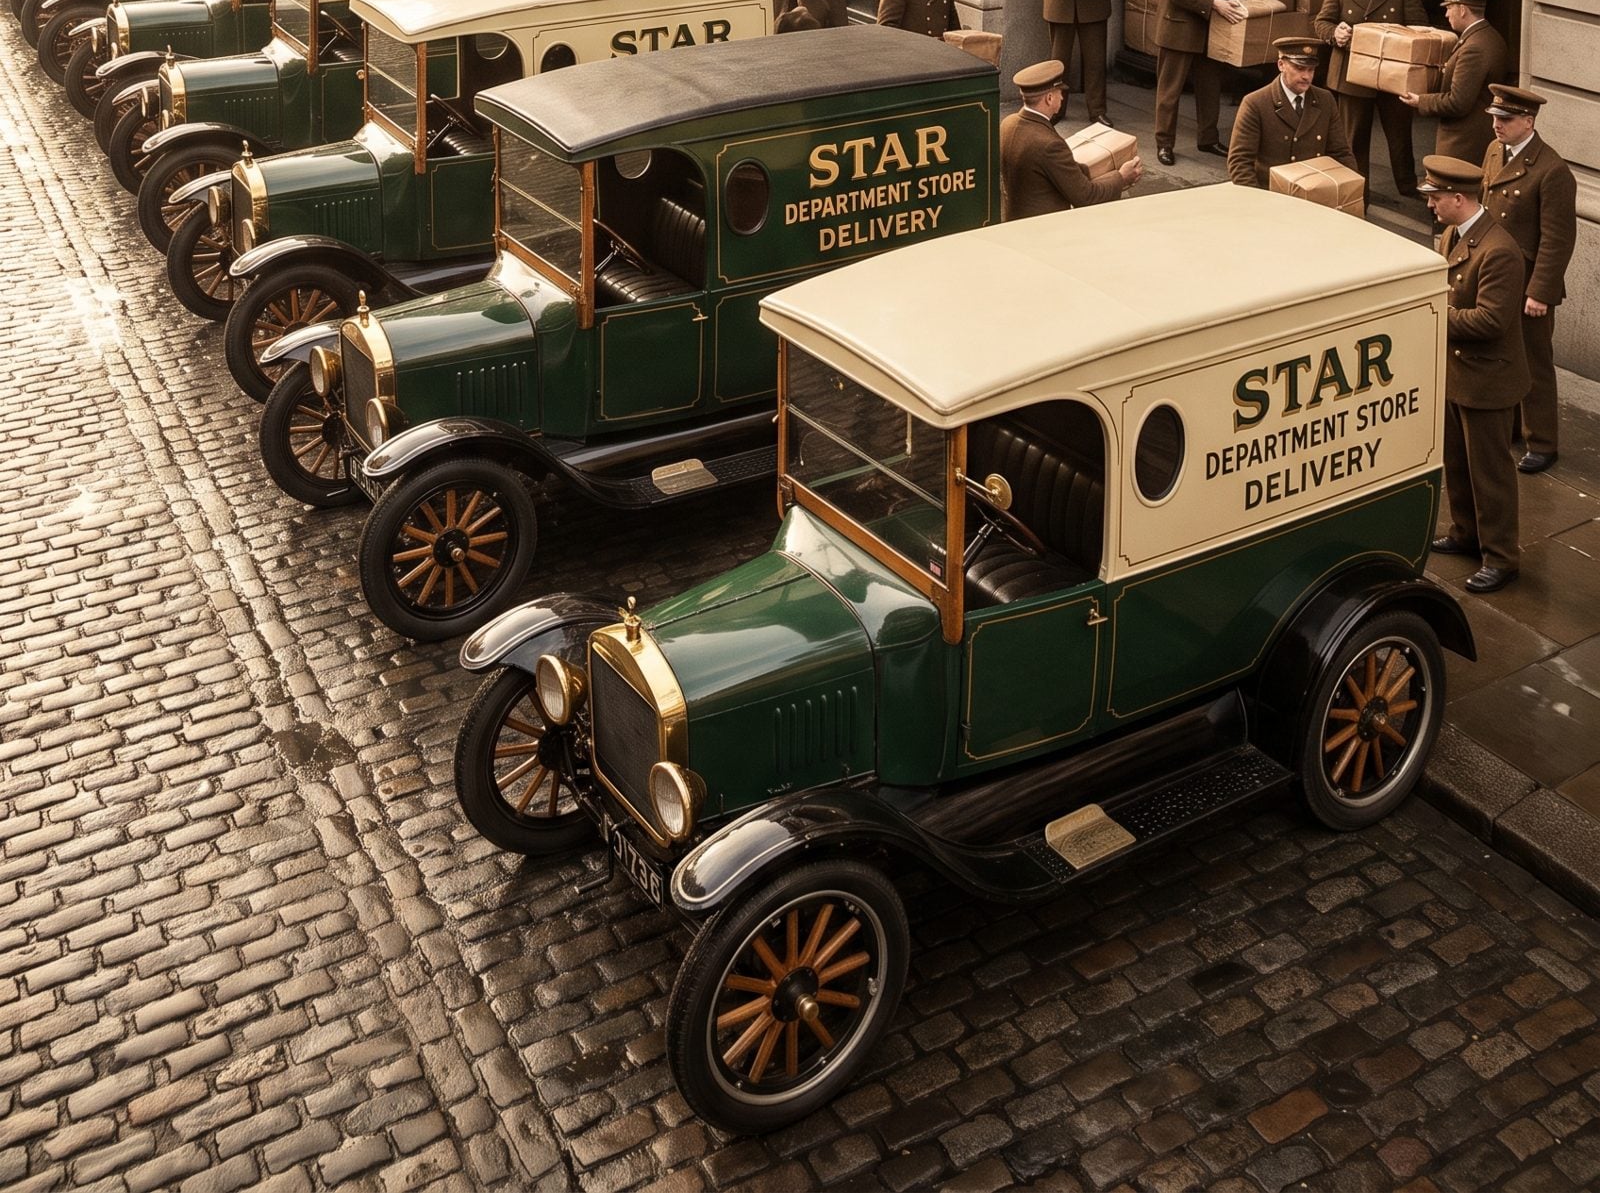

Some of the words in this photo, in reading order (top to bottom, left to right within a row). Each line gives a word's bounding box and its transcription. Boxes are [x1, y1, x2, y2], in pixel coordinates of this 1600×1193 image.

[610, 19, 731, 58] STAR
[809, 125, 950, 190] STAR
[785, 181, 911, 225] DEPARTMENT
[917, 168, 976, 199] STORE
[819, 205, 943, 252] DELIVERY
[1232, 333, 1394, 434] STAR
[1206, 410, 1349, 481] DEPARTMENT
[1356, 387, 1419, 432] STORE
[1244, 437, 1382, 511] DELIVERY
